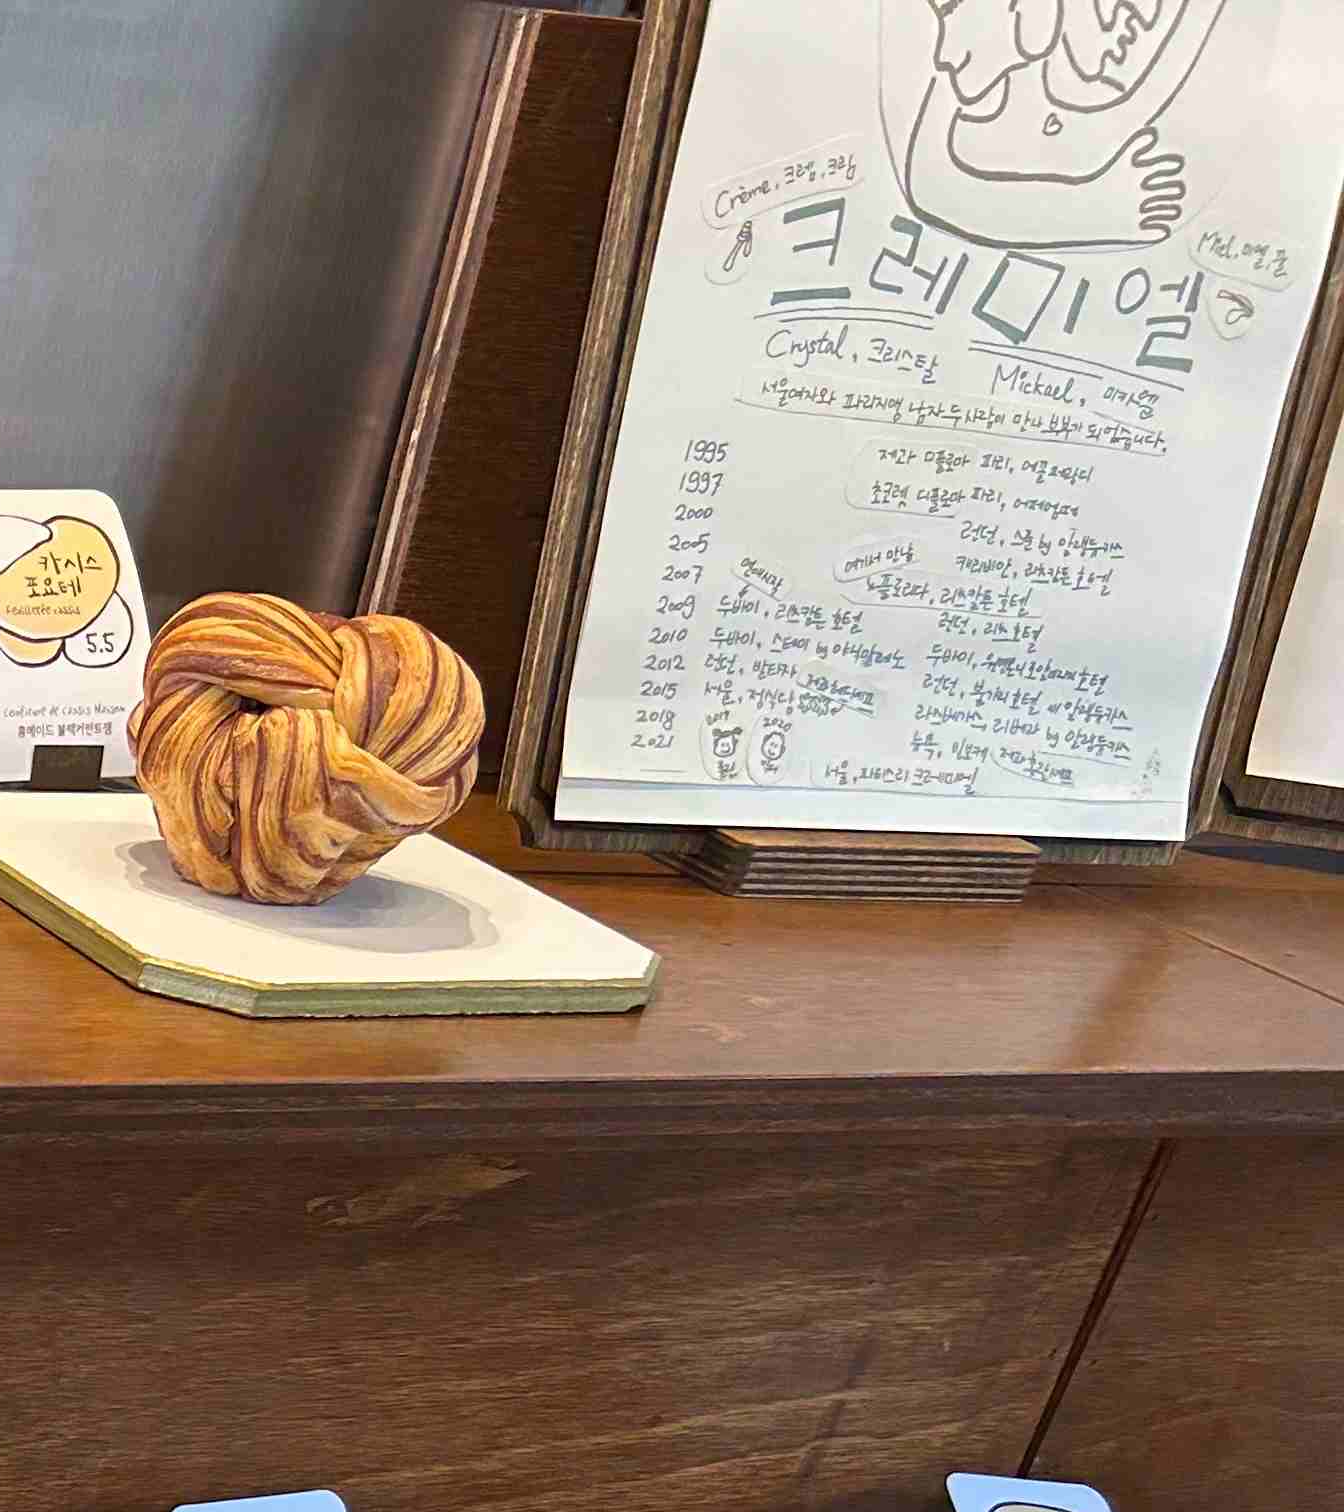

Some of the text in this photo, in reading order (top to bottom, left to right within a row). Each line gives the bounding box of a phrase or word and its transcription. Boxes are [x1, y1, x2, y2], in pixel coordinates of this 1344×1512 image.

[769, 197, 1203, 374] 크레미엘
[867, 338, 940, 384] 크리스탈
[842, 393, 904, 424] 파리지앵
[1103, 385, 1160, 420] 미카엘
[683, 440, 729, 464] 1995
[678, 470, 724, 497] 1997
[668, 531, 712, 553] 2005
[674, 503, 713, 522] 2000
[1038, 533, 1053, 556] by
[38, 550, 103, 576] 카시스
[661, 564, 705, 586] 2007
[656, 594, 697, 620] 2009
[86, 632, 115, 653] 5.5
[648, 627, 689, 644] 2010
[815, 641, 828, 660] by
[643, 655, 686, 672] 2012
[635, 709, 676, 732] 2018
[639, 680, 680, 698] 2015
[1045, 726, 1060, 748] by
[630, 733, 675, 748] 2021
